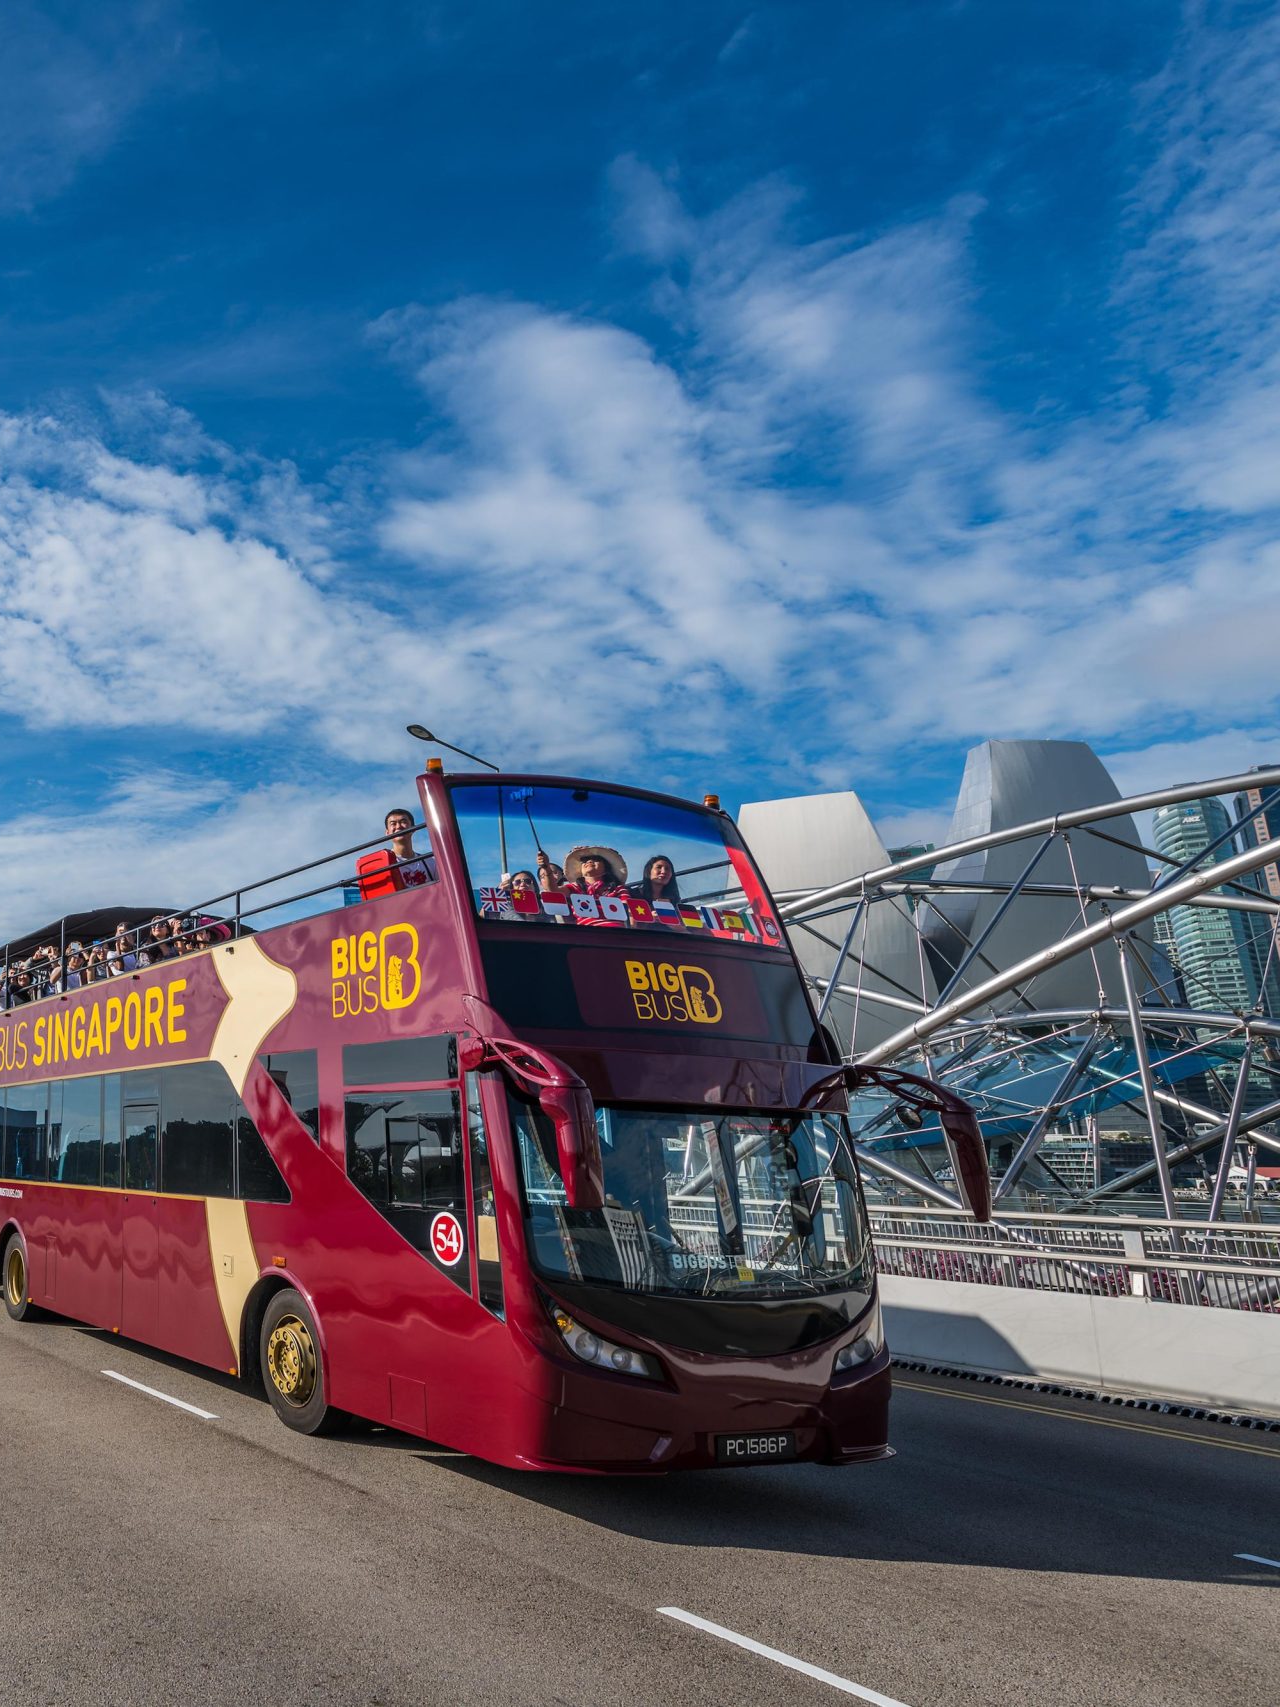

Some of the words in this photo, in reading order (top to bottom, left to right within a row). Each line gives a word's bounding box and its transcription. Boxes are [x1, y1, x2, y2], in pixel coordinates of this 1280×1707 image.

[332, 931, 377, 979] BIG
[625, 961, 680, 992] BIG
[332, 976, 378, 1018] BUS
[632, 993, 688, 1021] BUS
[32, 978, 187, 1066] SINGAPORE
[436, 1223, 459, 1253] 54
[726, 1436, 787, 1456] PC1586P
